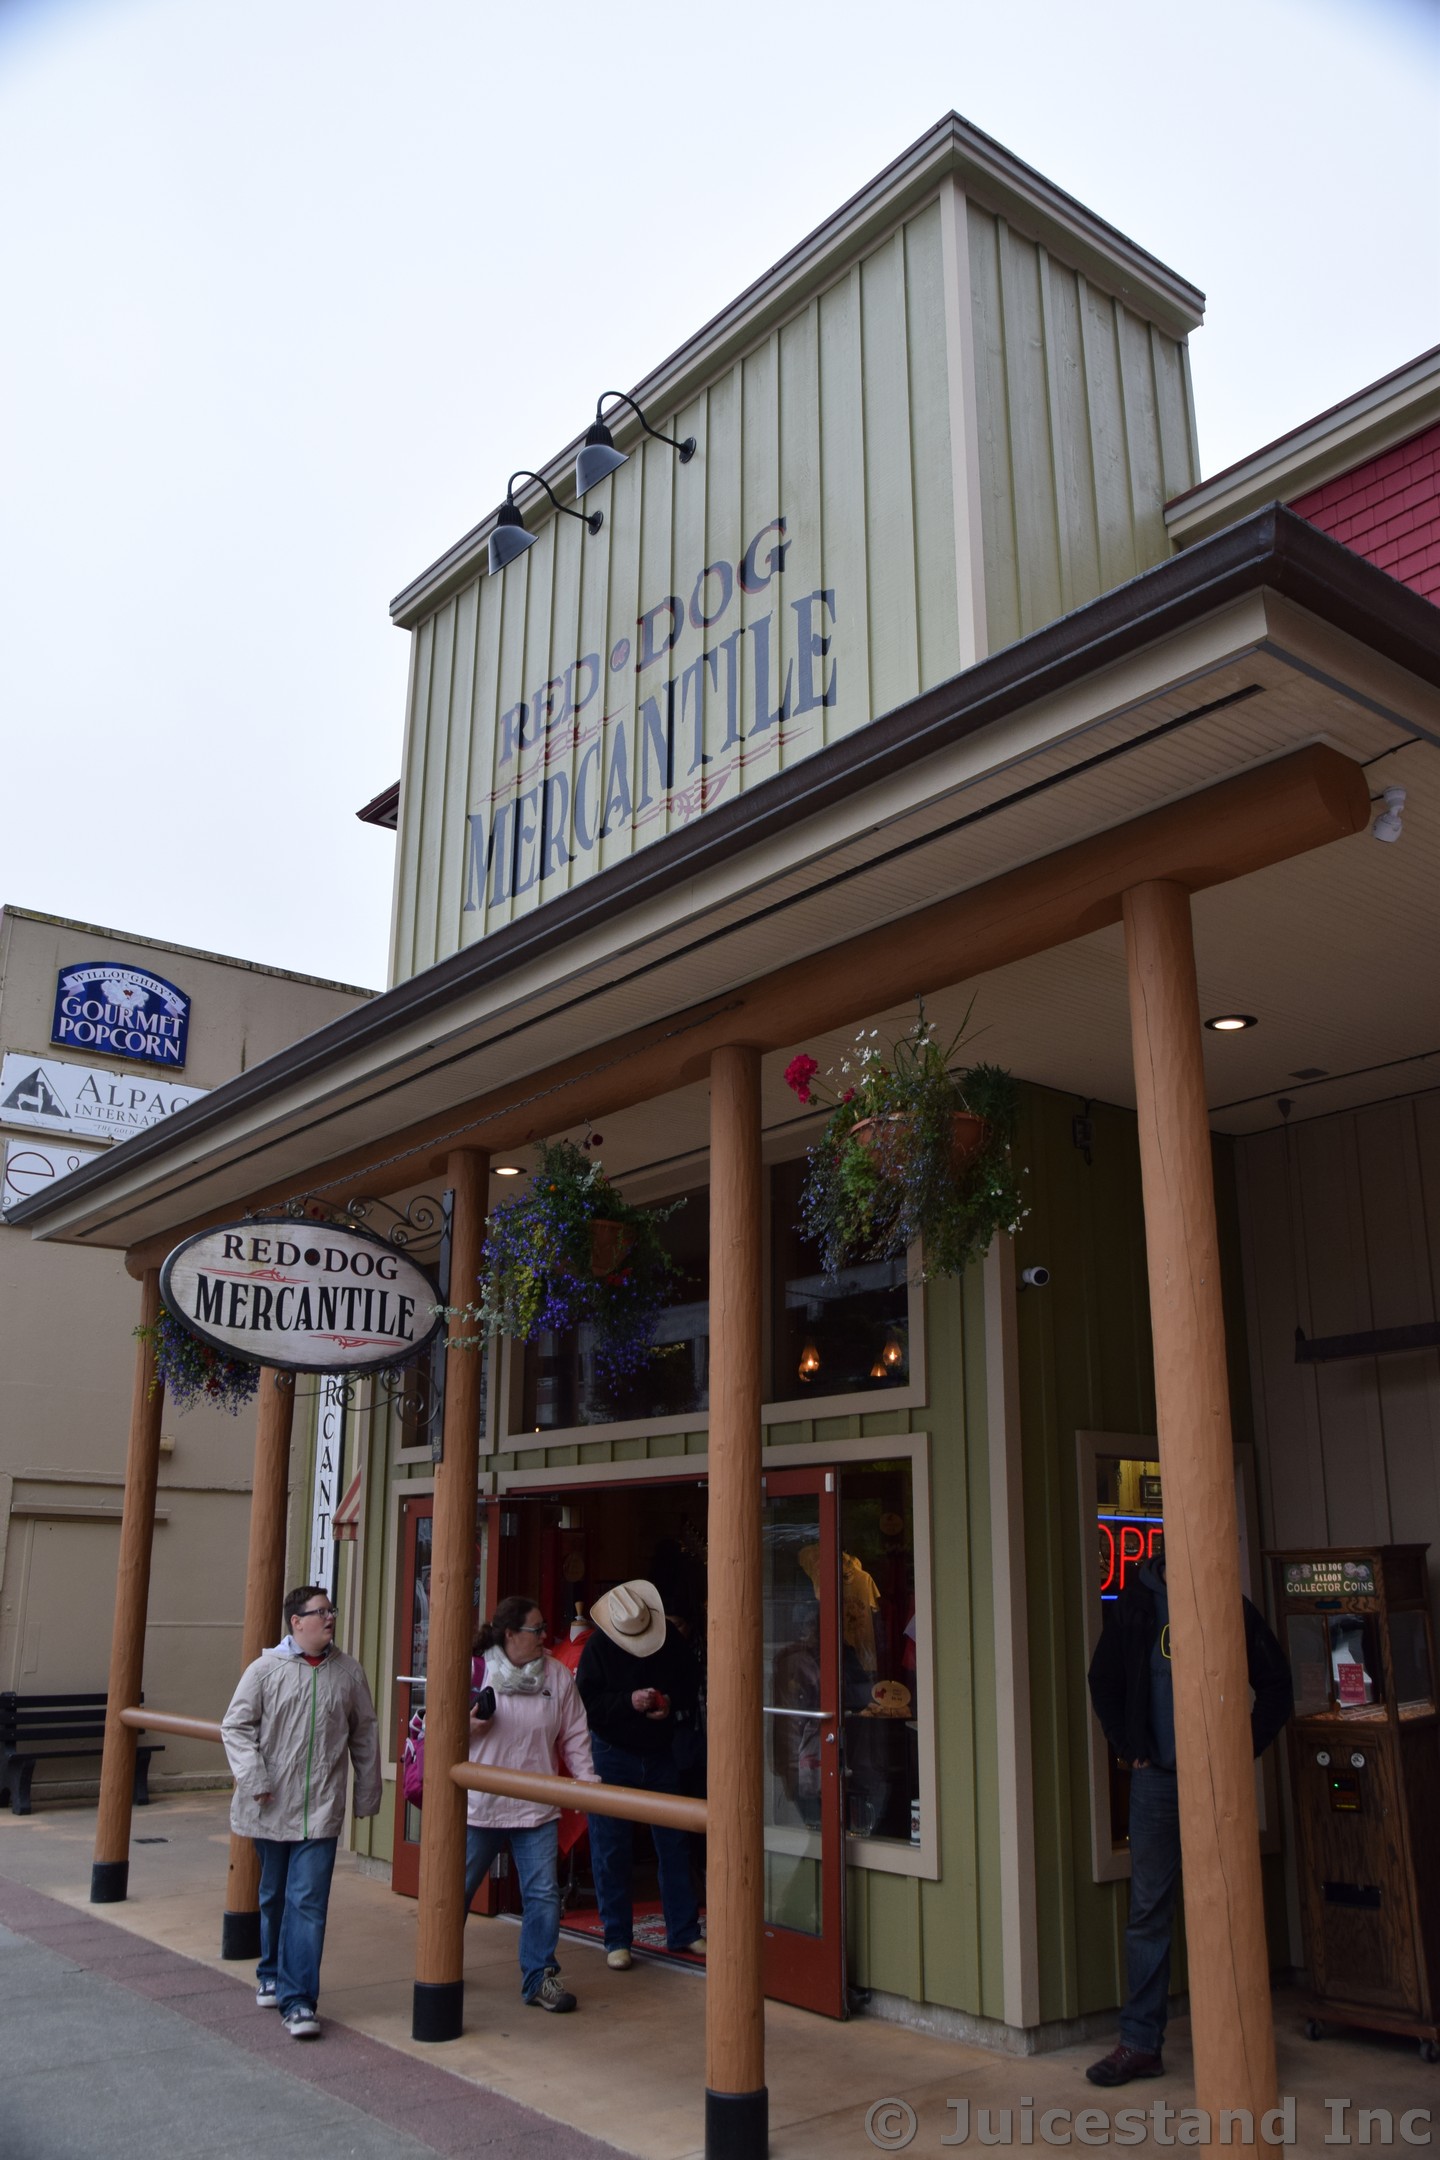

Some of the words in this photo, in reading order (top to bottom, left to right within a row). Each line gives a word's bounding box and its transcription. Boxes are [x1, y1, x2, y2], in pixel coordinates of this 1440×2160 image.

[498, 652, 600, 767] RED
[635, 516, 793, 674] DOG
[464, 588, 838, 912] MERCANTILE
[70, 970, 178, 1006] WILLOUGHBY'S
[58, 1016, 182, 1060] POPCORN
[60, 996, 185, 1038] GOURMET
[221, 1233, 302, 1267] RED
[323, 1247, 400, 1281] DOG
[193, 1272, 416, 1342] MERCANTILE
[315, 1379, 337, 1589] RCANTI
[1286, 1582, 1341, 1593] COLLECTOR
[1343, 1580, 1374, 1592] COINS
[1312, 1563, 1327, 1572] RED
[1328, 1562, 1343, 1571] DOG
[1313, 1573, 1342, 1582] SALOON
